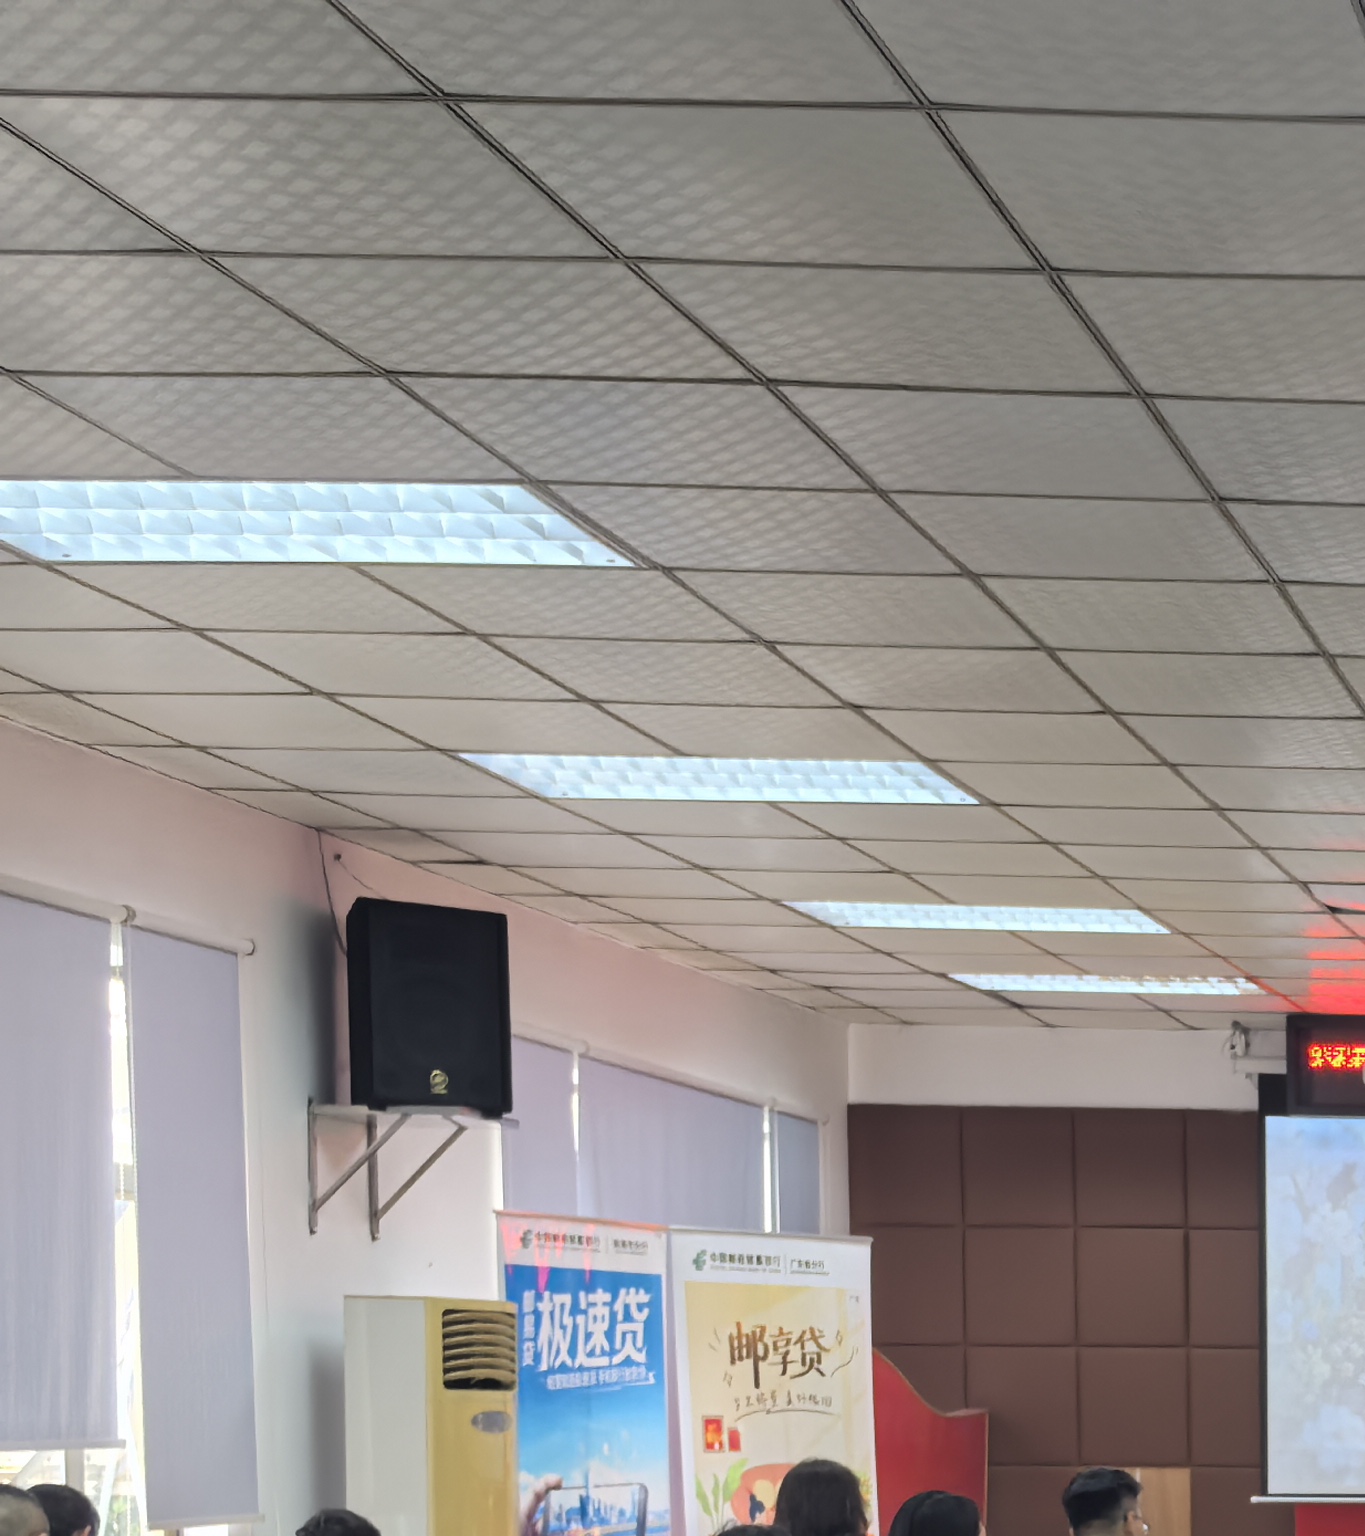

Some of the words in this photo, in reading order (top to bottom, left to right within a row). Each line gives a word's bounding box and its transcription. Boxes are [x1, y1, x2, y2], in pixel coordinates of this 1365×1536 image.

[536, 1287, 650, 1371] 极速贷
[728, 1321, 832, 1390] 邮享贷
